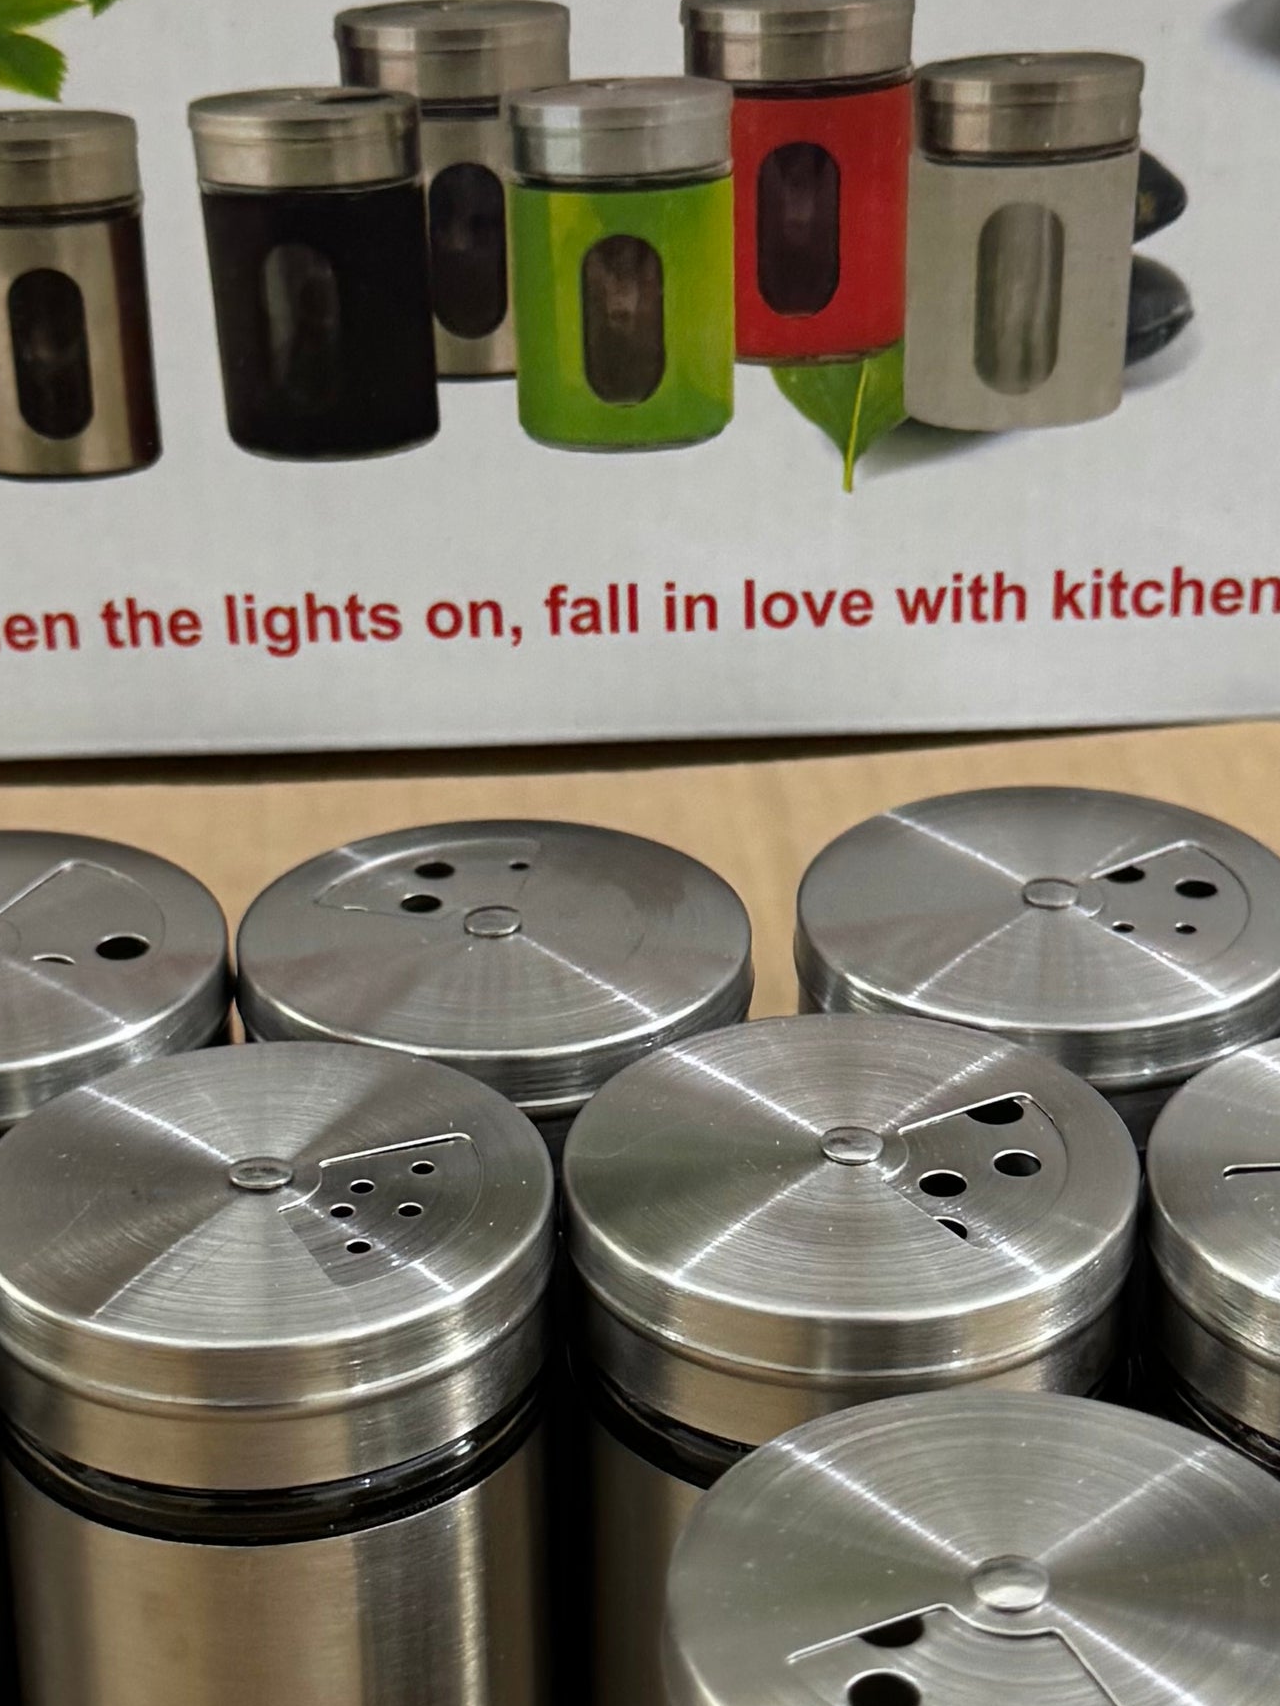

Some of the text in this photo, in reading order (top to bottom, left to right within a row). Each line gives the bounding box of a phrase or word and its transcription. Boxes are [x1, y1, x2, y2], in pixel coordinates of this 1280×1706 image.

[100, 596, 202, 651] the
[223, 592, 403, 659] lights
[424, 598, 523, 647] on,
[543, 582, 639, 637] fall
[663, 580, 718, 633] in
[743, 578, 874, 631] love
[895, 571, 1028, 627] with
